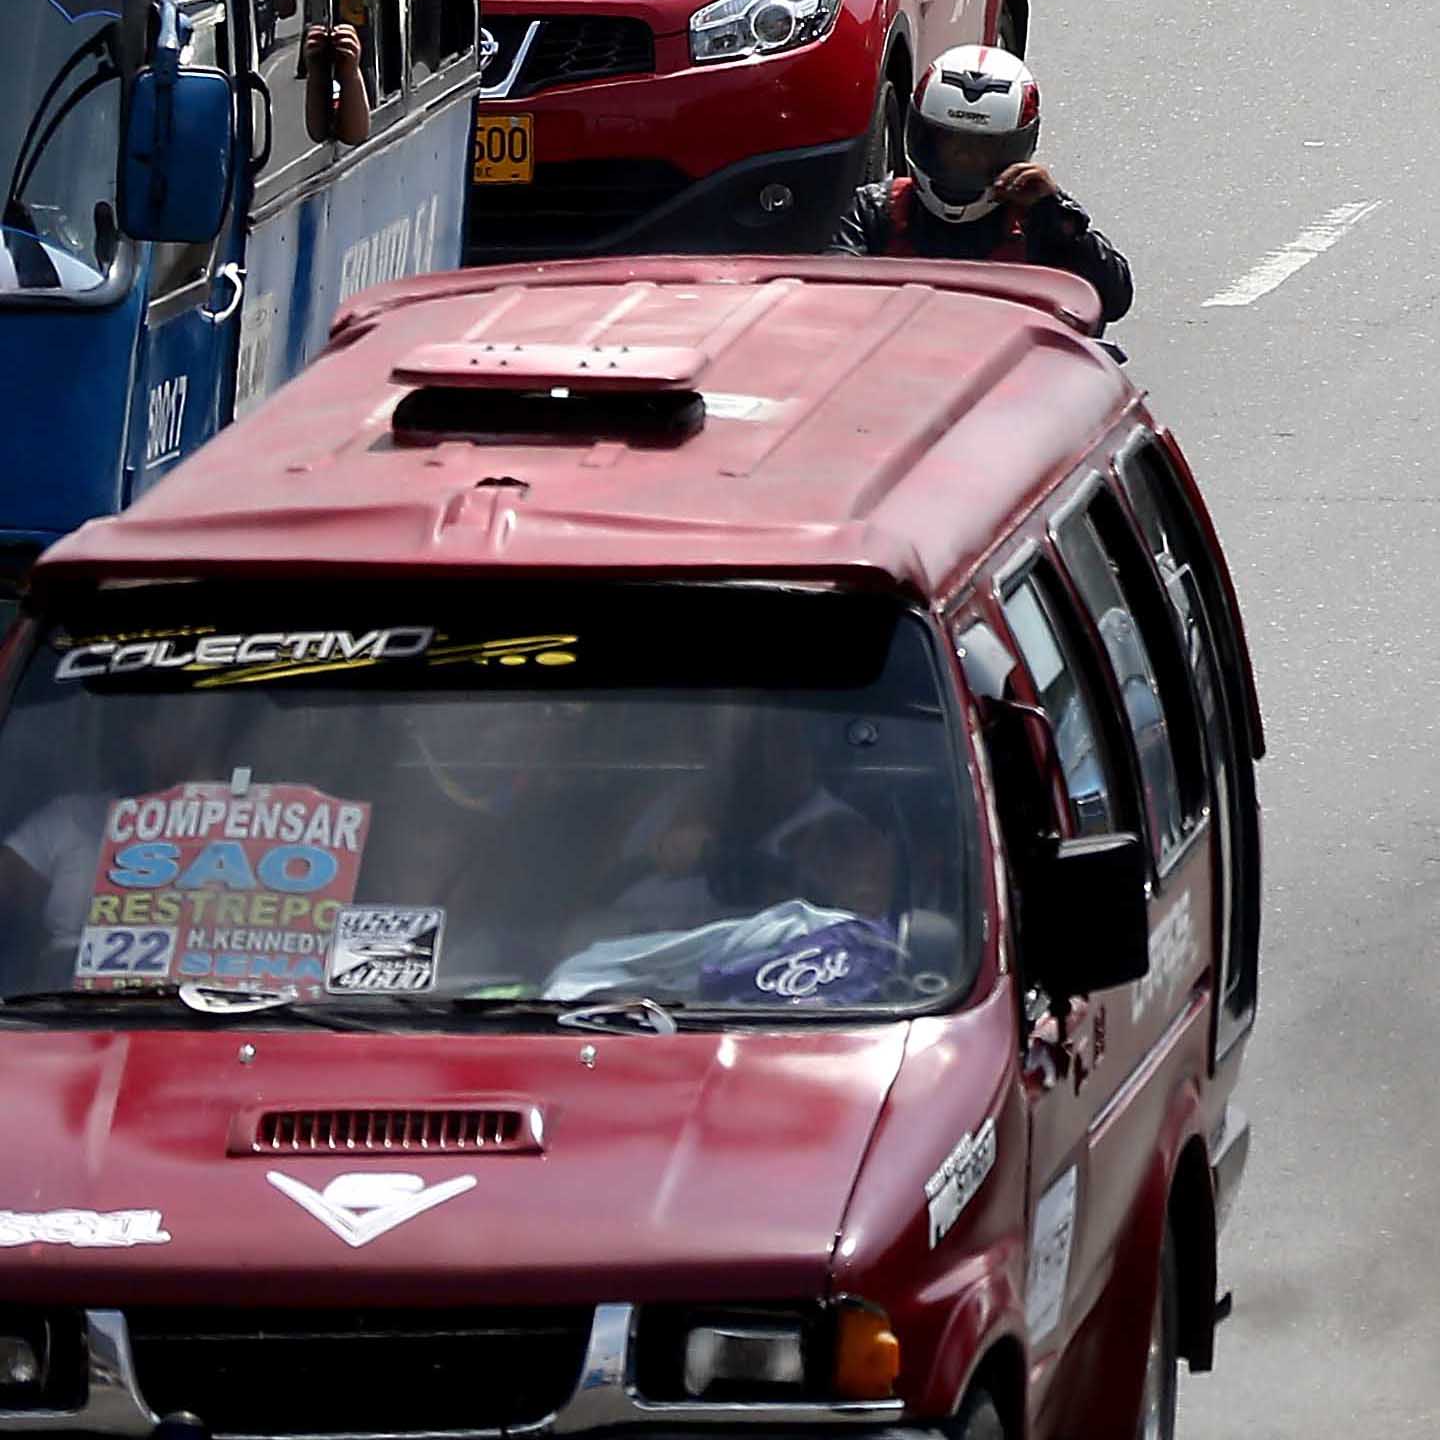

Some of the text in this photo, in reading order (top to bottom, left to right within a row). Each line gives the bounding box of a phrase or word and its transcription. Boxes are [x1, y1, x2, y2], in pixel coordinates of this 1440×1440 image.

[55, 626, 434, 681] COLECTIVO
[110, 796, 367, 852] COMPENSAR
[108, 841, 338, 892] SAO
[89, 891, 343, 928] RESTREPO
[98, 930, 171, 972] 22
[186, 927, 333, 954] H.KENNEDY
